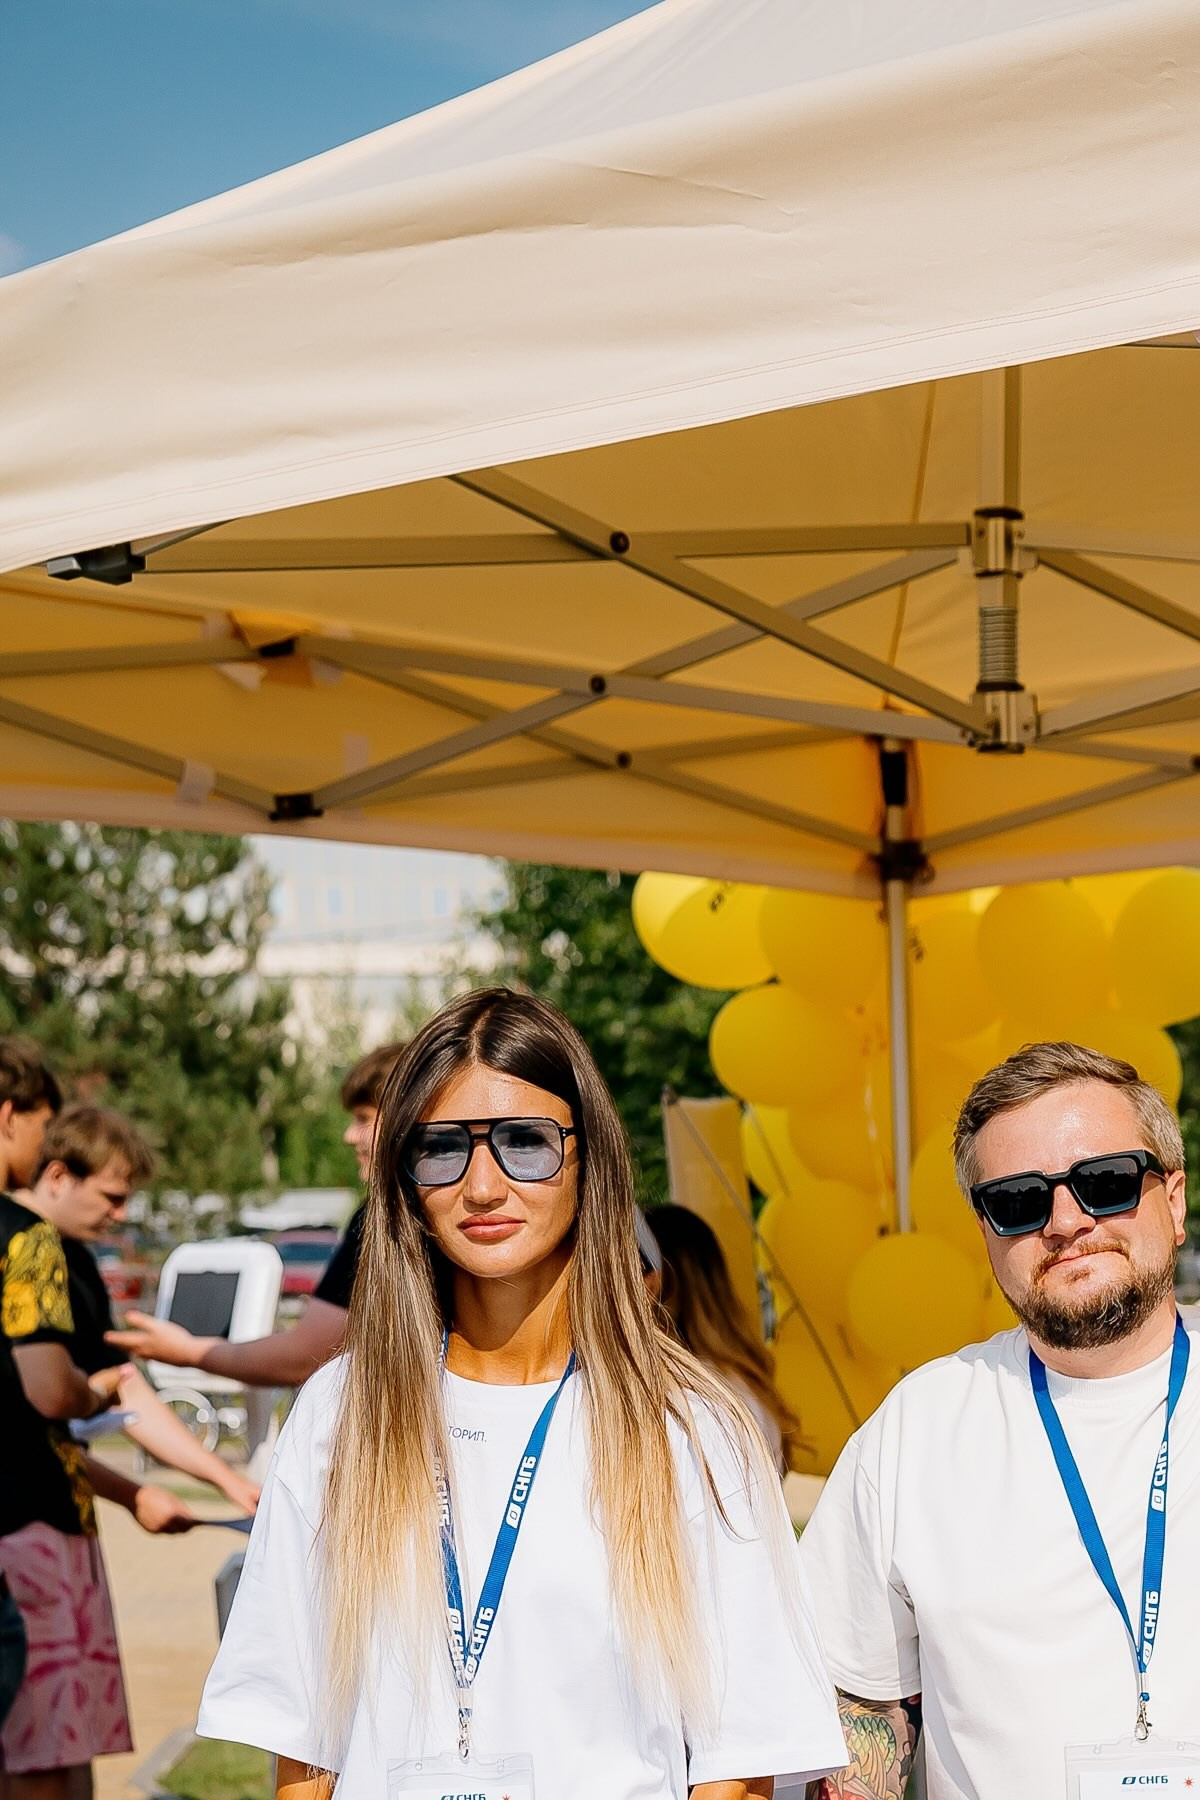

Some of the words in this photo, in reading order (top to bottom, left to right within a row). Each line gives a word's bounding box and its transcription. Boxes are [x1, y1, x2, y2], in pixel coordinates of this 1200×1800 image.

[512, 1456, 537, 1503] СНГБ
[470, 1607, 494, 1655] СНГБ
[1144, 1590, 1159, 1640] СНГБ
[1139, 1775, 1169, 1785] СНГБ
